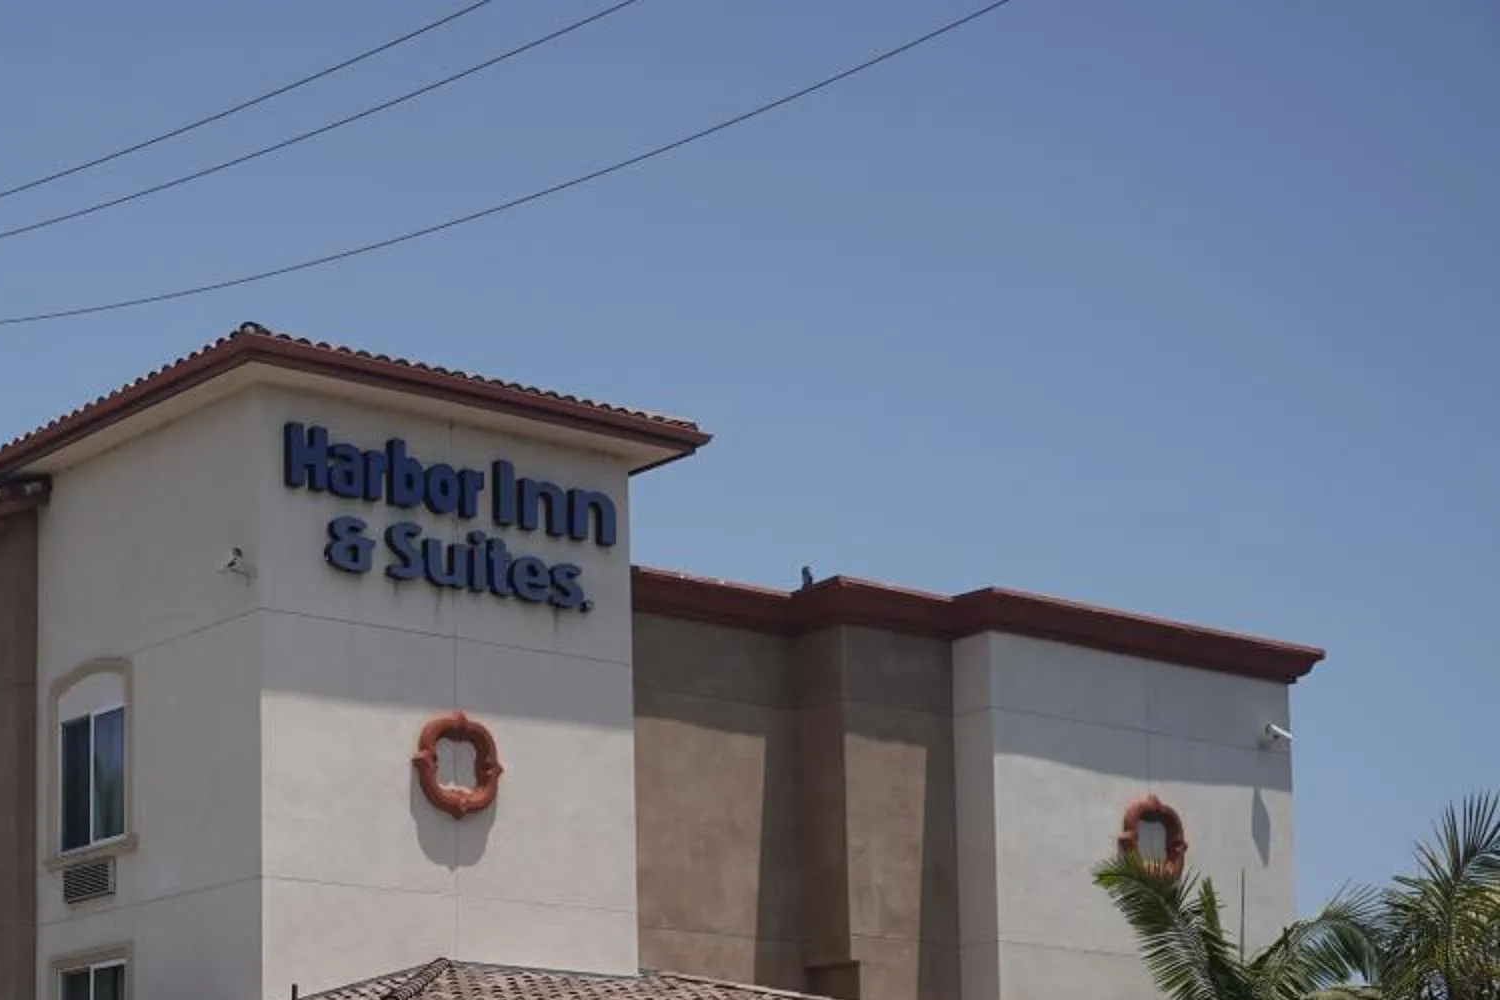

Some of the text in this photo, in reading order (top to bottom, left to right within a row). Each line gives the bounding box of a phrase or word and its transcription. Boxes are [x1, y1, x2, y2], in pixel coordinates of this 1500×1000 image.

[284, 421, 617, 547] Harbor Inn
[324, 515, 376, 574] &
